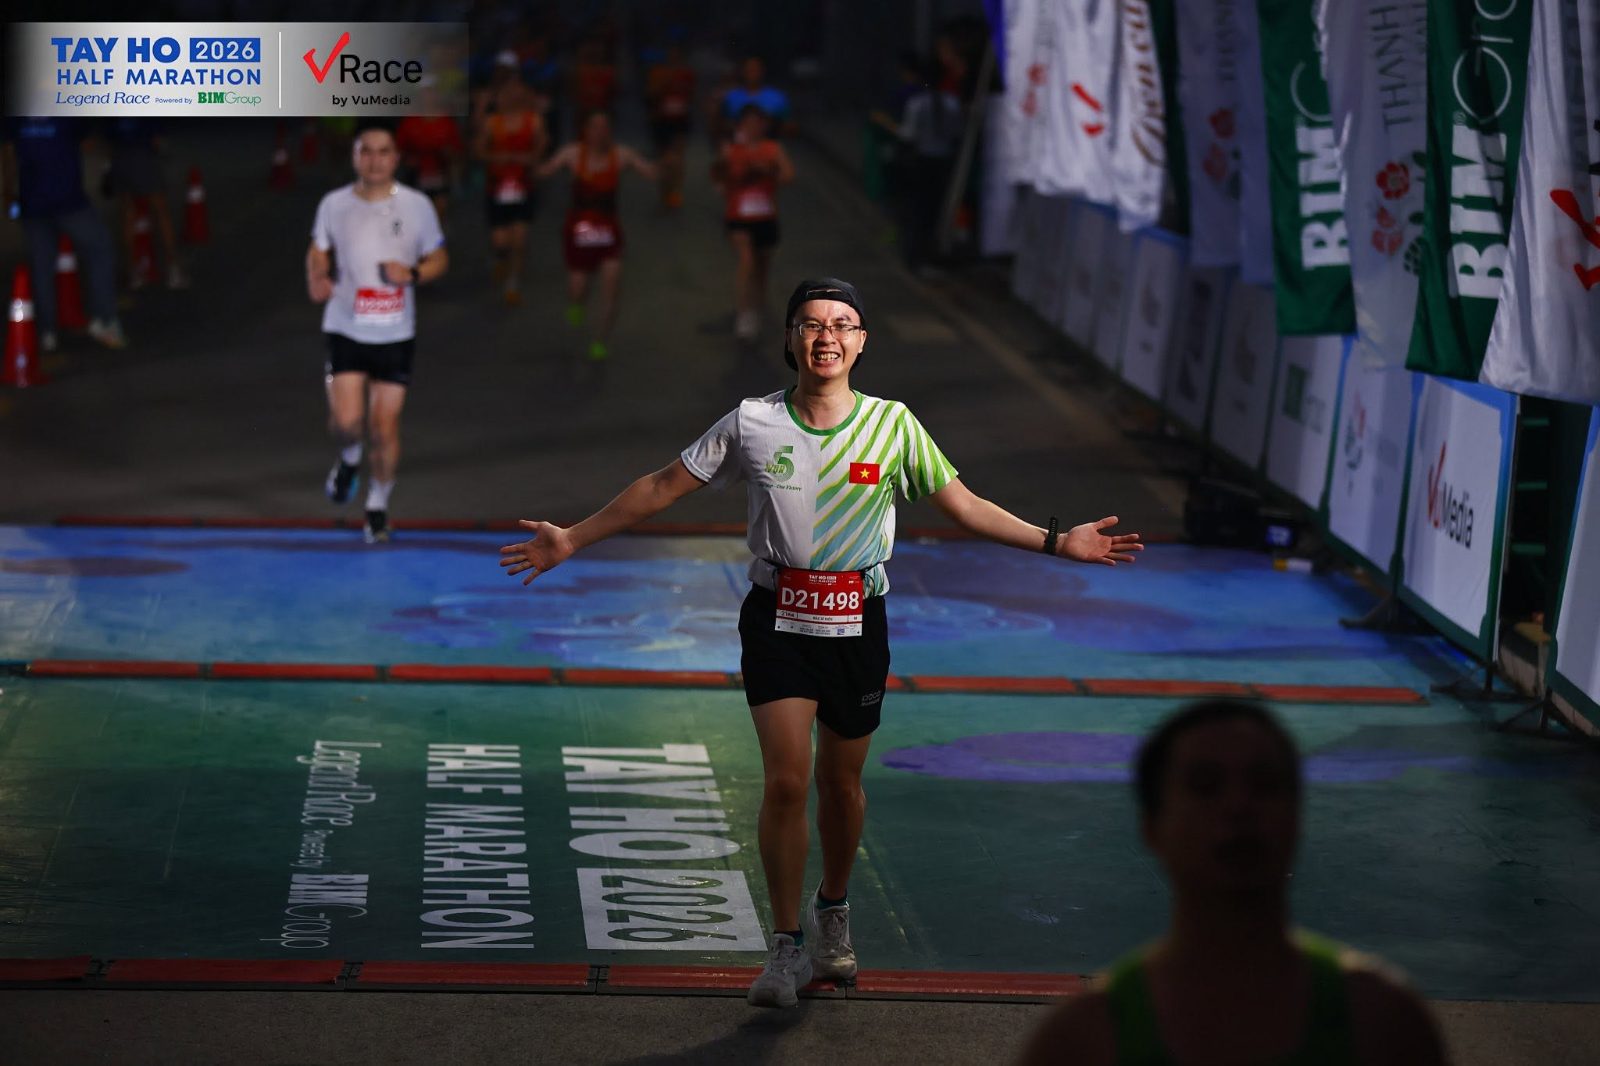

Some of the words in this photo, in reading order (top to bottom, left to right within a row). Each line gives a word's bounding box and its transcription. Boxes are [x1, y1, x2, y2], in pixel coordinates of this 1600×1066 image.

[781, 587, 860, 610] D21498
[296, 740, 382, 789] Legend
[427, 743, 523, 795] HALF
[561, 743, 722, 803] TAY
[299, 790, 377, 827] Race
[568, 806, 741, 861] HO
[420, 803, 535, 950] MARATHON
[600, 873, 740, 944] 2026
